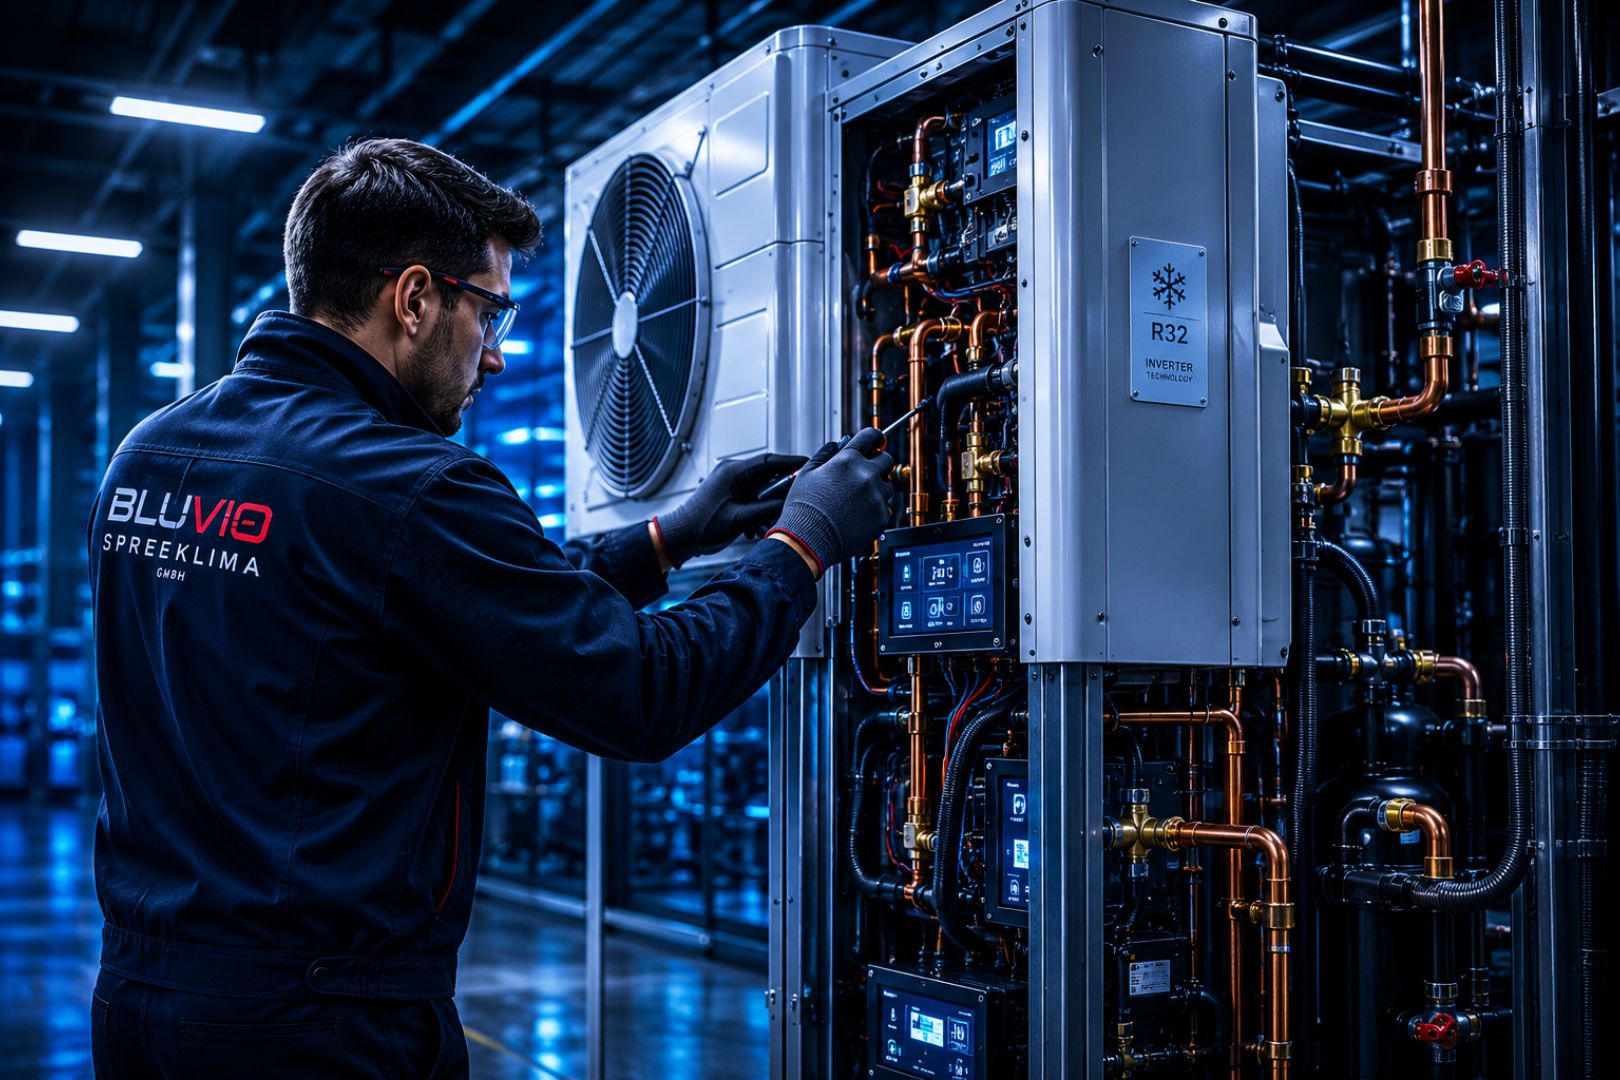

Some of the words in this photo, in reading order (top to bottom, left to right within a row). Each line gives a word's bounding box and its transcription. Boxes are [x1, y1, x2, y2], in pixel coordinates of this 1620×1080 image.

[1152, 322, 1187, 344] R32
[1146, 358, 1193, 373] INVERTER
[107, 487, 273, 543] BLUVIO
[102, 533, 260, 577] SPREEKLIMA
[156, 567, 186, 581] GMBH
